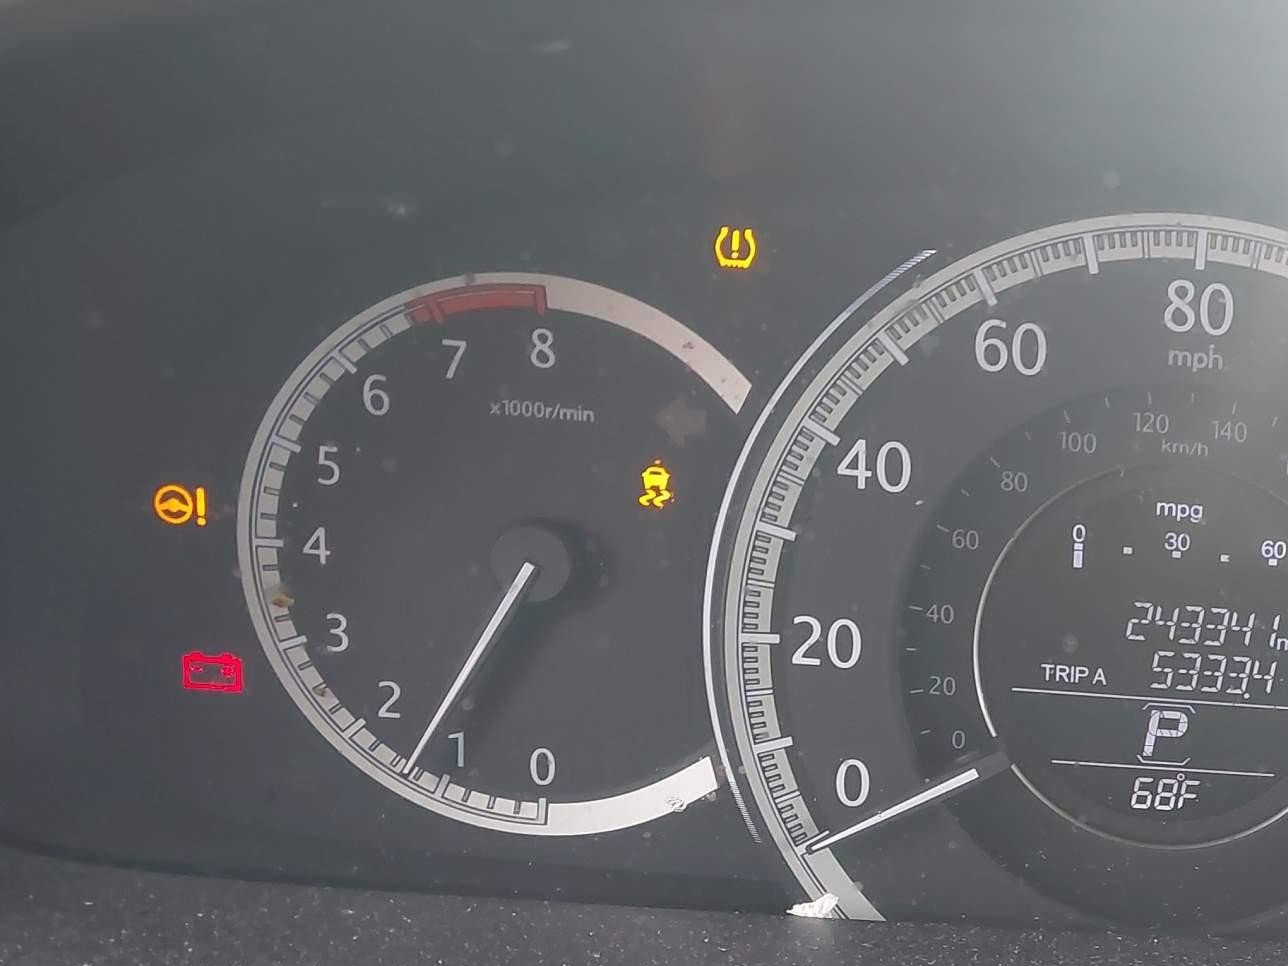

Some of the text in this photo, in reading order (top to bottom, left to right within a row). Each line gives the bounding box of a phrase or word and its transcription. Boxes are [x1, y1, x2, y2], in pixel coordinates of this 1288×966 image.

[1163, 279, 1235, 336] 80
[440, 338, 468, 379] 7
[530, 328, 556, 368] 8
[974, 319, 1048, 376] 60
[1168, 344, 1224, 372] mph
[362, 374, 391, 416] 6
[489, 400, 595, 424] x1000r/min
[1134, 412, 1169, 434] 120
[1211, 420, 1248, 443] 140
[1060, 431, 1097, 454] 100
[1161, 439, 1208, 458] km/h
[317, 446, 341, 486] 5
[837, 439, 912, 493] 40
[1000, 471, 1028, 493] 80
[1156, 501, 1204, 523] mpg
[303, 527, 331, 565] 4
[951, 528, 979, 551] 60
[1072, 524, 1287, 560] 0 30 60
[325, 613, 349, 652] 3
[926, 603, 955, 625] 40
[1125, 601, 1281, 648] 243341
[791, 615, 862, 669] 20
[928, 676, 956, 697] 20
[1041, 663, 1089, 685] TRIP
[1092, 667, 1108, 686] A
[377, 680, 401, 719] 2
[447, 731, 466, 768] 1
[951, 730, 966, 750] 0
[1142, 710, 1191, 757] P
[529, 748, 556, 785] 0
[835, 758, 871, 808] 0
